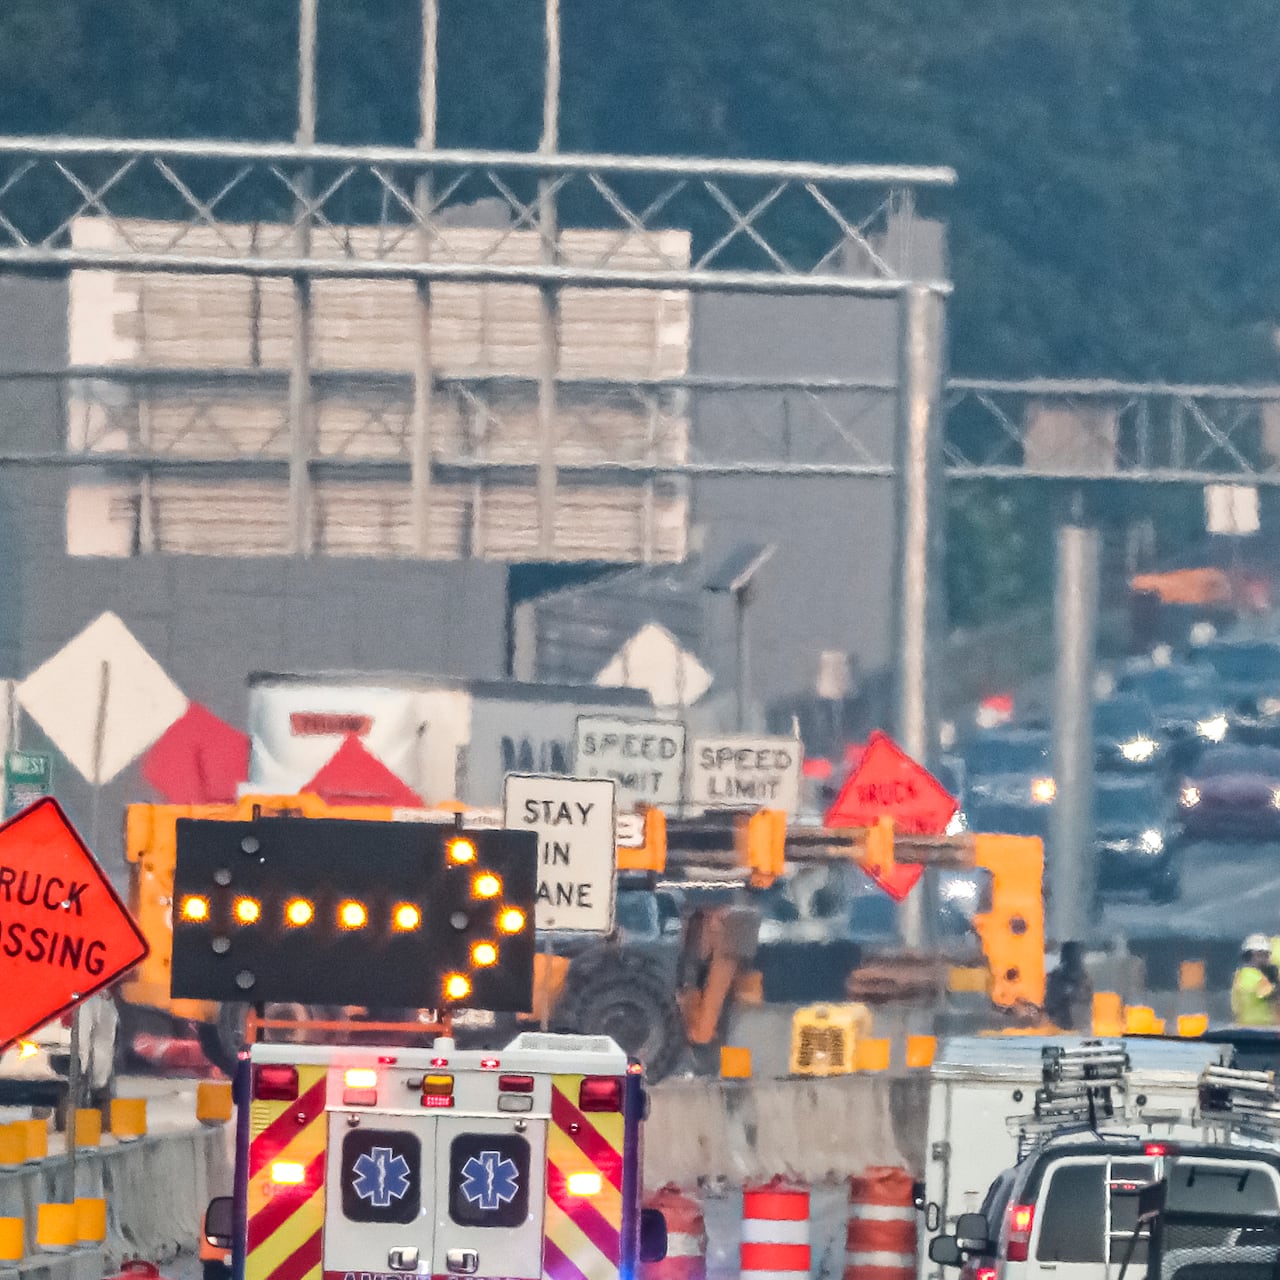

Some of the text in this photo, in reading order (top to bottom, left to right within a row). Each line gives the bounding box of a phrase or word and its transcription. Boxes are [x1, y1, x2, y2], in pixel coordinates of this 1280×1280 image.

[582, 732, 678, 760] SPEED
[699, 746, 793, 772] SPEED
[707, 775, 782, 801] LIMIT
[523, 799, 595, 826] STAY
[543, 842, 570, 866] IN
[537, 882, 593, 909] ANE
[0, 921, 107, 976] SSING
